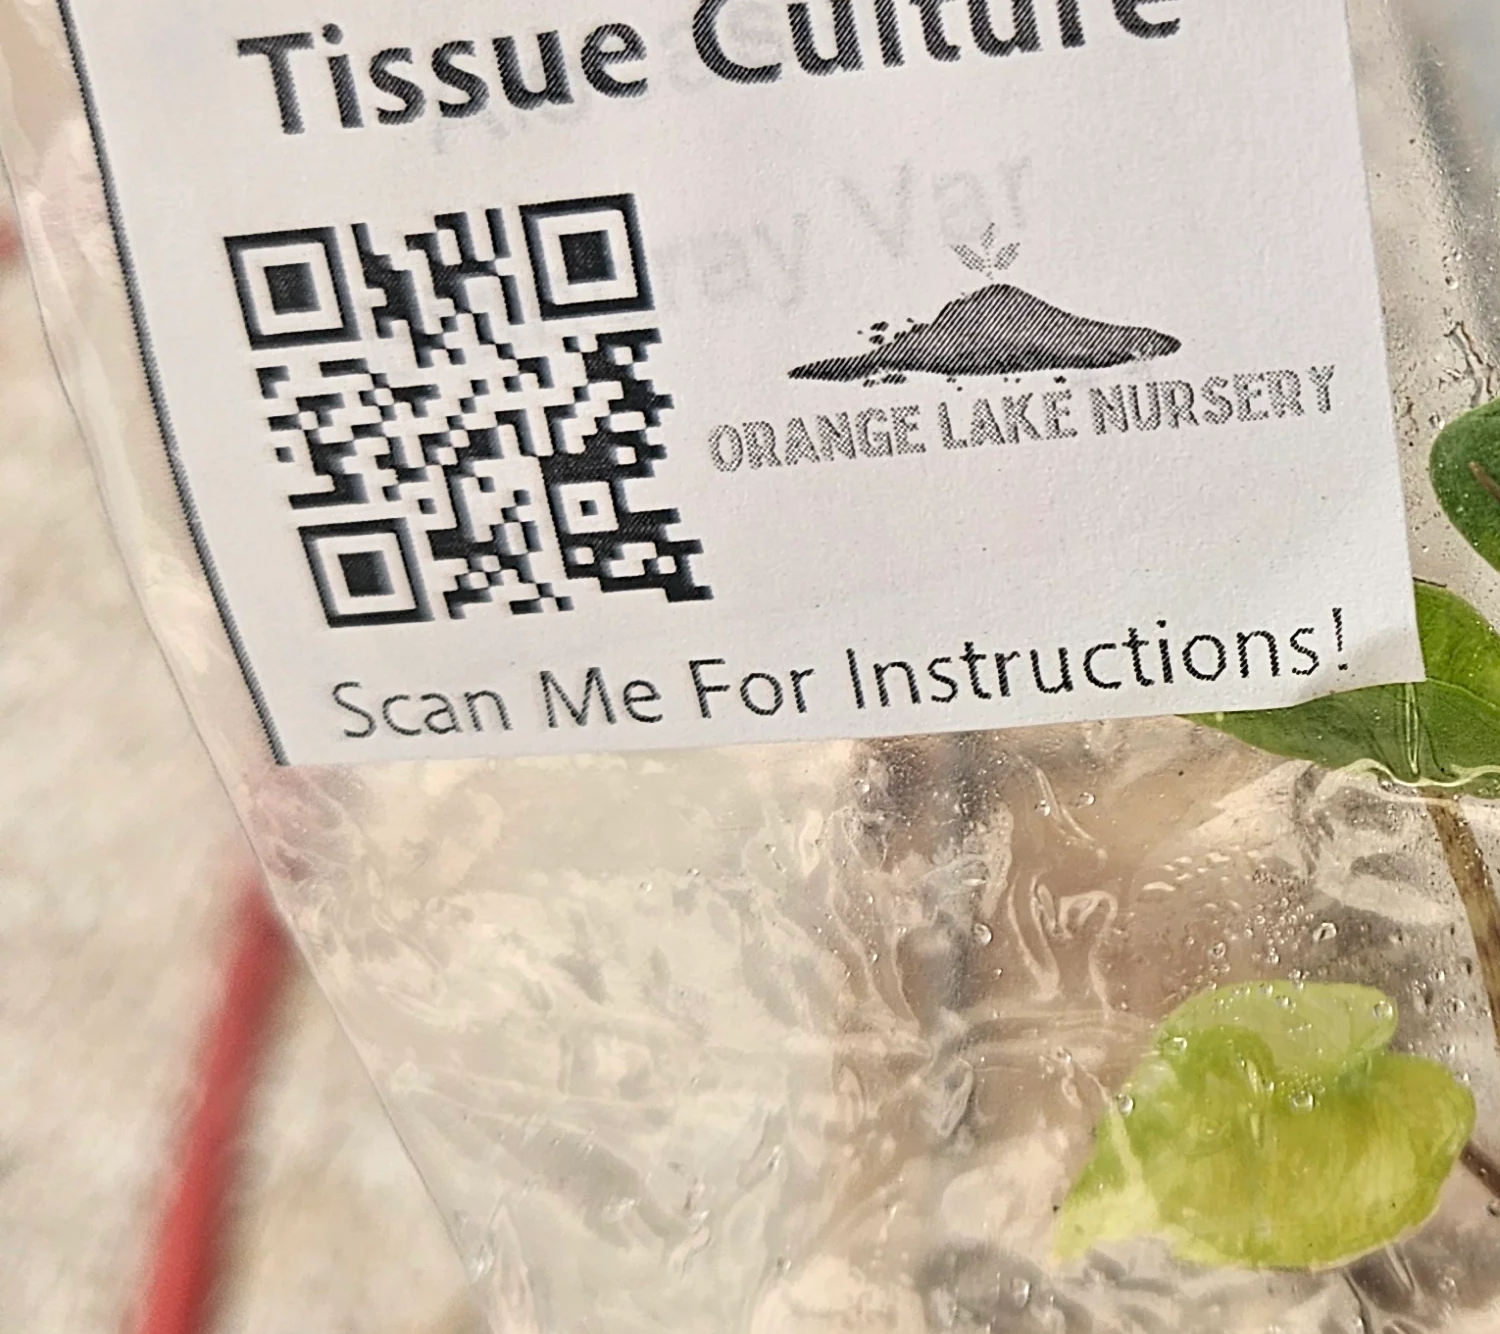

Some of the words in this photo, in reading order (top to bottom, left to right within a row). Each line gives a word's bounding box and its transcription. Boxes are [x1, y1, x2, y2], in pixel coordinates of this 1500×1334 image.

[236, 23, 648, 135] Tissue
[710, 405, 928, 471] ORANGE
[938, 391, 1078, 450] LAKE
[1087, 364, 1336, 435] NURSERY
[331, 679, 511, 740] Scan
[537, 666, 663, 730] Me
[687, 656, 814, 720] For
[845, 609, 1352, 711] Instructions!
